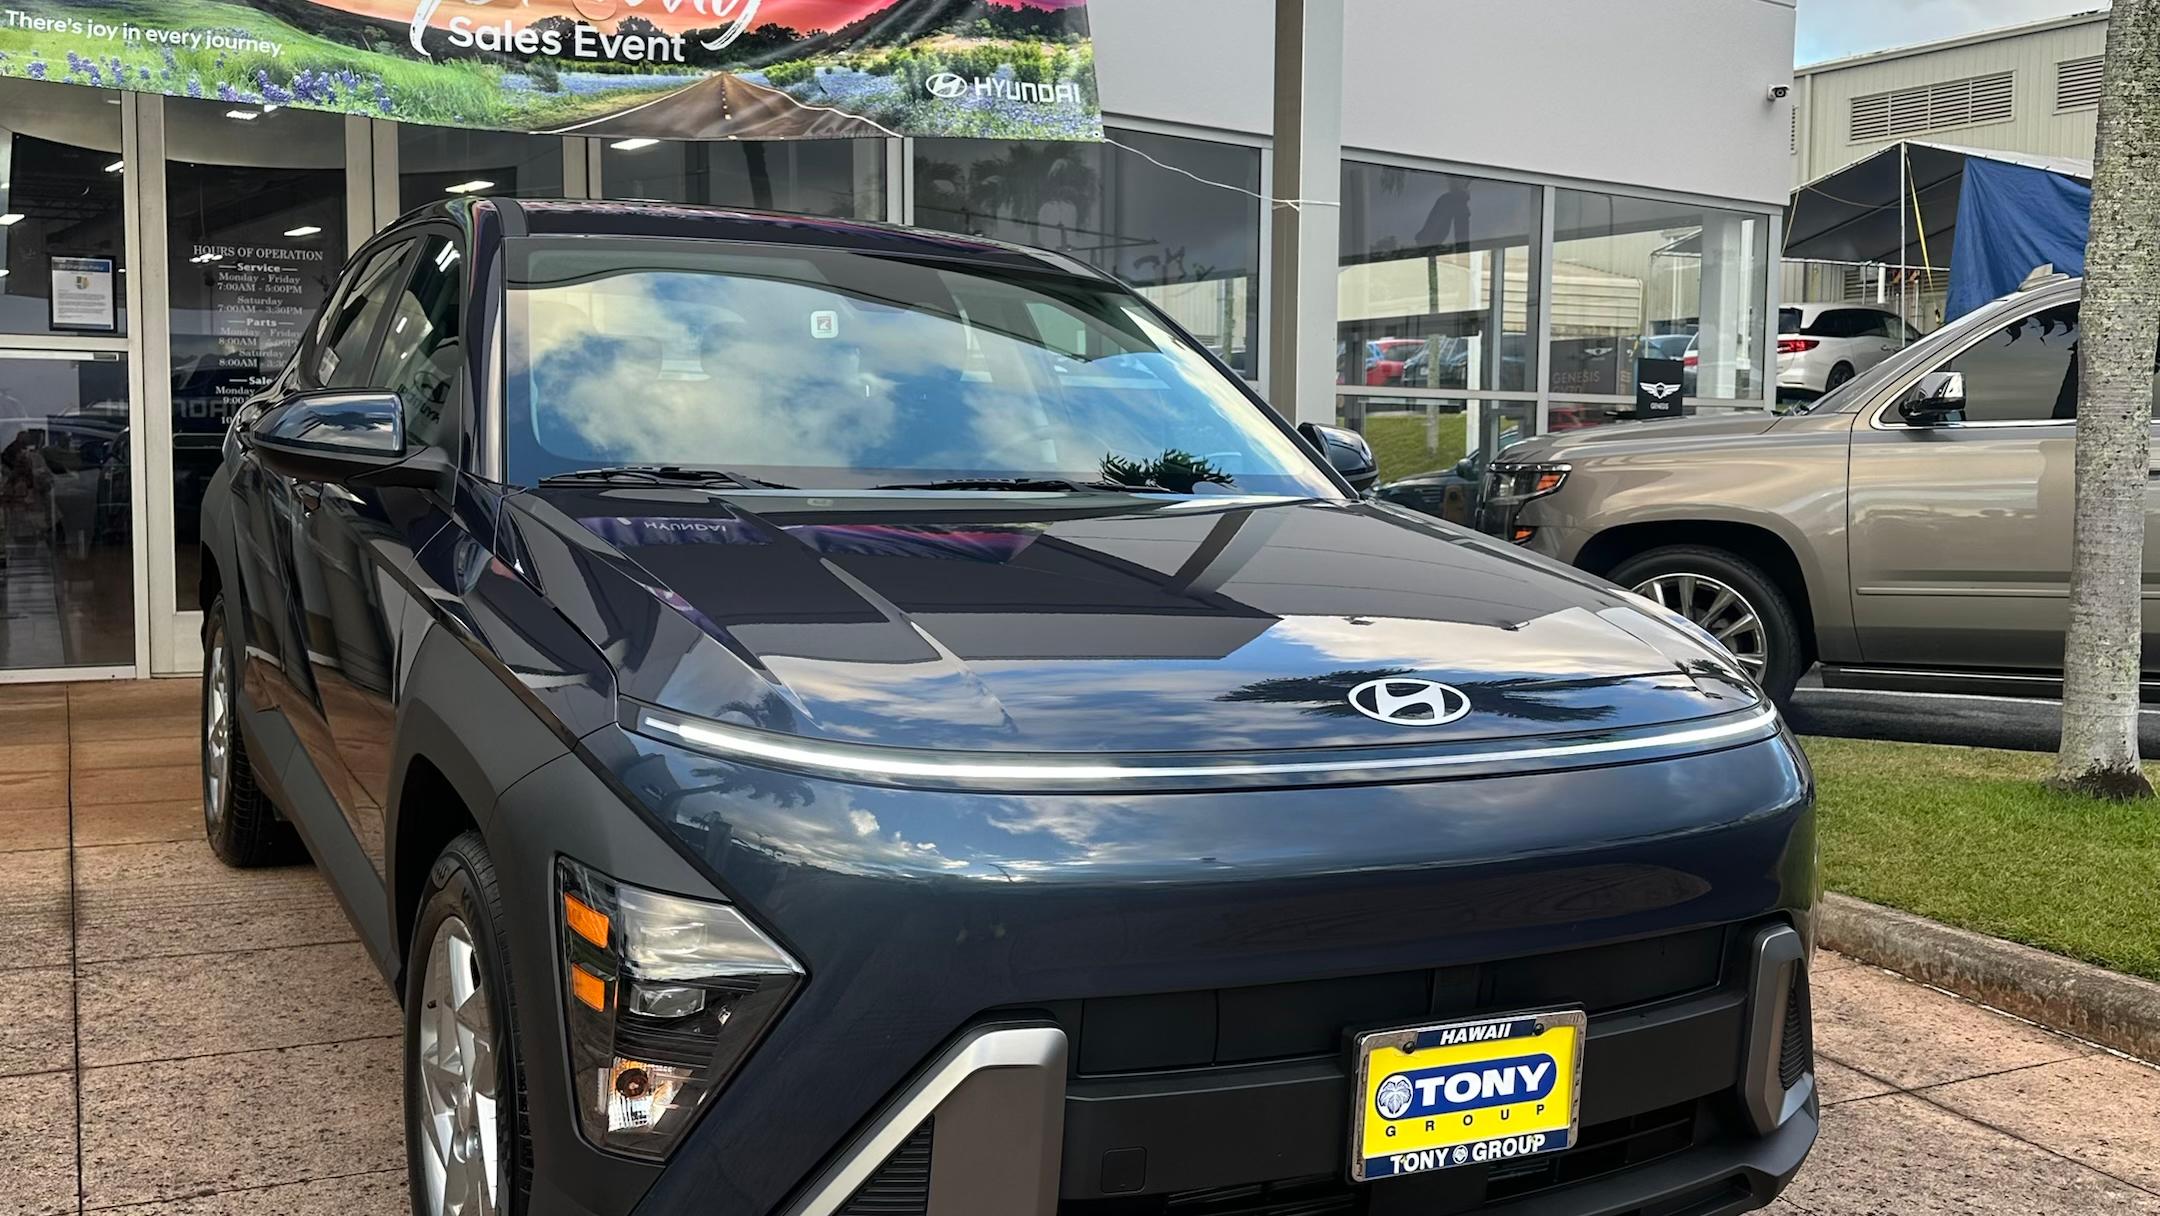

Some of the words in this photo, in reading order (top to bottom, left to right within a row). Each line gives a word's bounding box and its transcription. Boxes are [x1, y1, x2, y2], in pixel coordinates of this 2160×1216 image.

[4, 9, 83, 35] There's
[86, 19, 118, 41] joy
[123, 23, 141, 41] in
[145, 28, 203, 49] every
[204, 30, 286, 58] journey.
[447, 16, 563, 56] Sales
[574, 24, 687, 63] Event
[973, 76, 1081, 103] HYUNDAI
[193, 245, 235, 257] HOURS
[237, 246, 254, 258] OF
[255, 247, 323, 261] OPERATION
[237, 262, 281, 273] Service
[218, 272, 259, 282] Monday
[268, 273, 301, 285] Friday
[217, 282, 256, 292] 7:00AM
[264, 283, 303, 295] 5:00PM
[237, 295, 283, 306] Saturday
[217, 304, 256, 314] 7:00AM
[246, 318, 277, 327] Parts
[219, 327, 259, 338] Monday
[270, 328, 301, 339] Friday
[218, 337, 257, 346] 8:00AM
[239, 349, 284, 359] Saturday
[218, 358, 258, 368] 8:00AM
[248, 376, 274, 386] Sale
[1552, 371, 1600, 385] GENESIS
[215, 386, 256, 397] Monday
[1439, 1023, 1512, 1046] HAWAII
[1414, 1061, 1551, 1107] TONY
[1385, 1104, 1545, 1137] GROUP
[1389, 1147, 1450, 1175] TONY
[1472, 1133, 1546, 1161] GROUP
